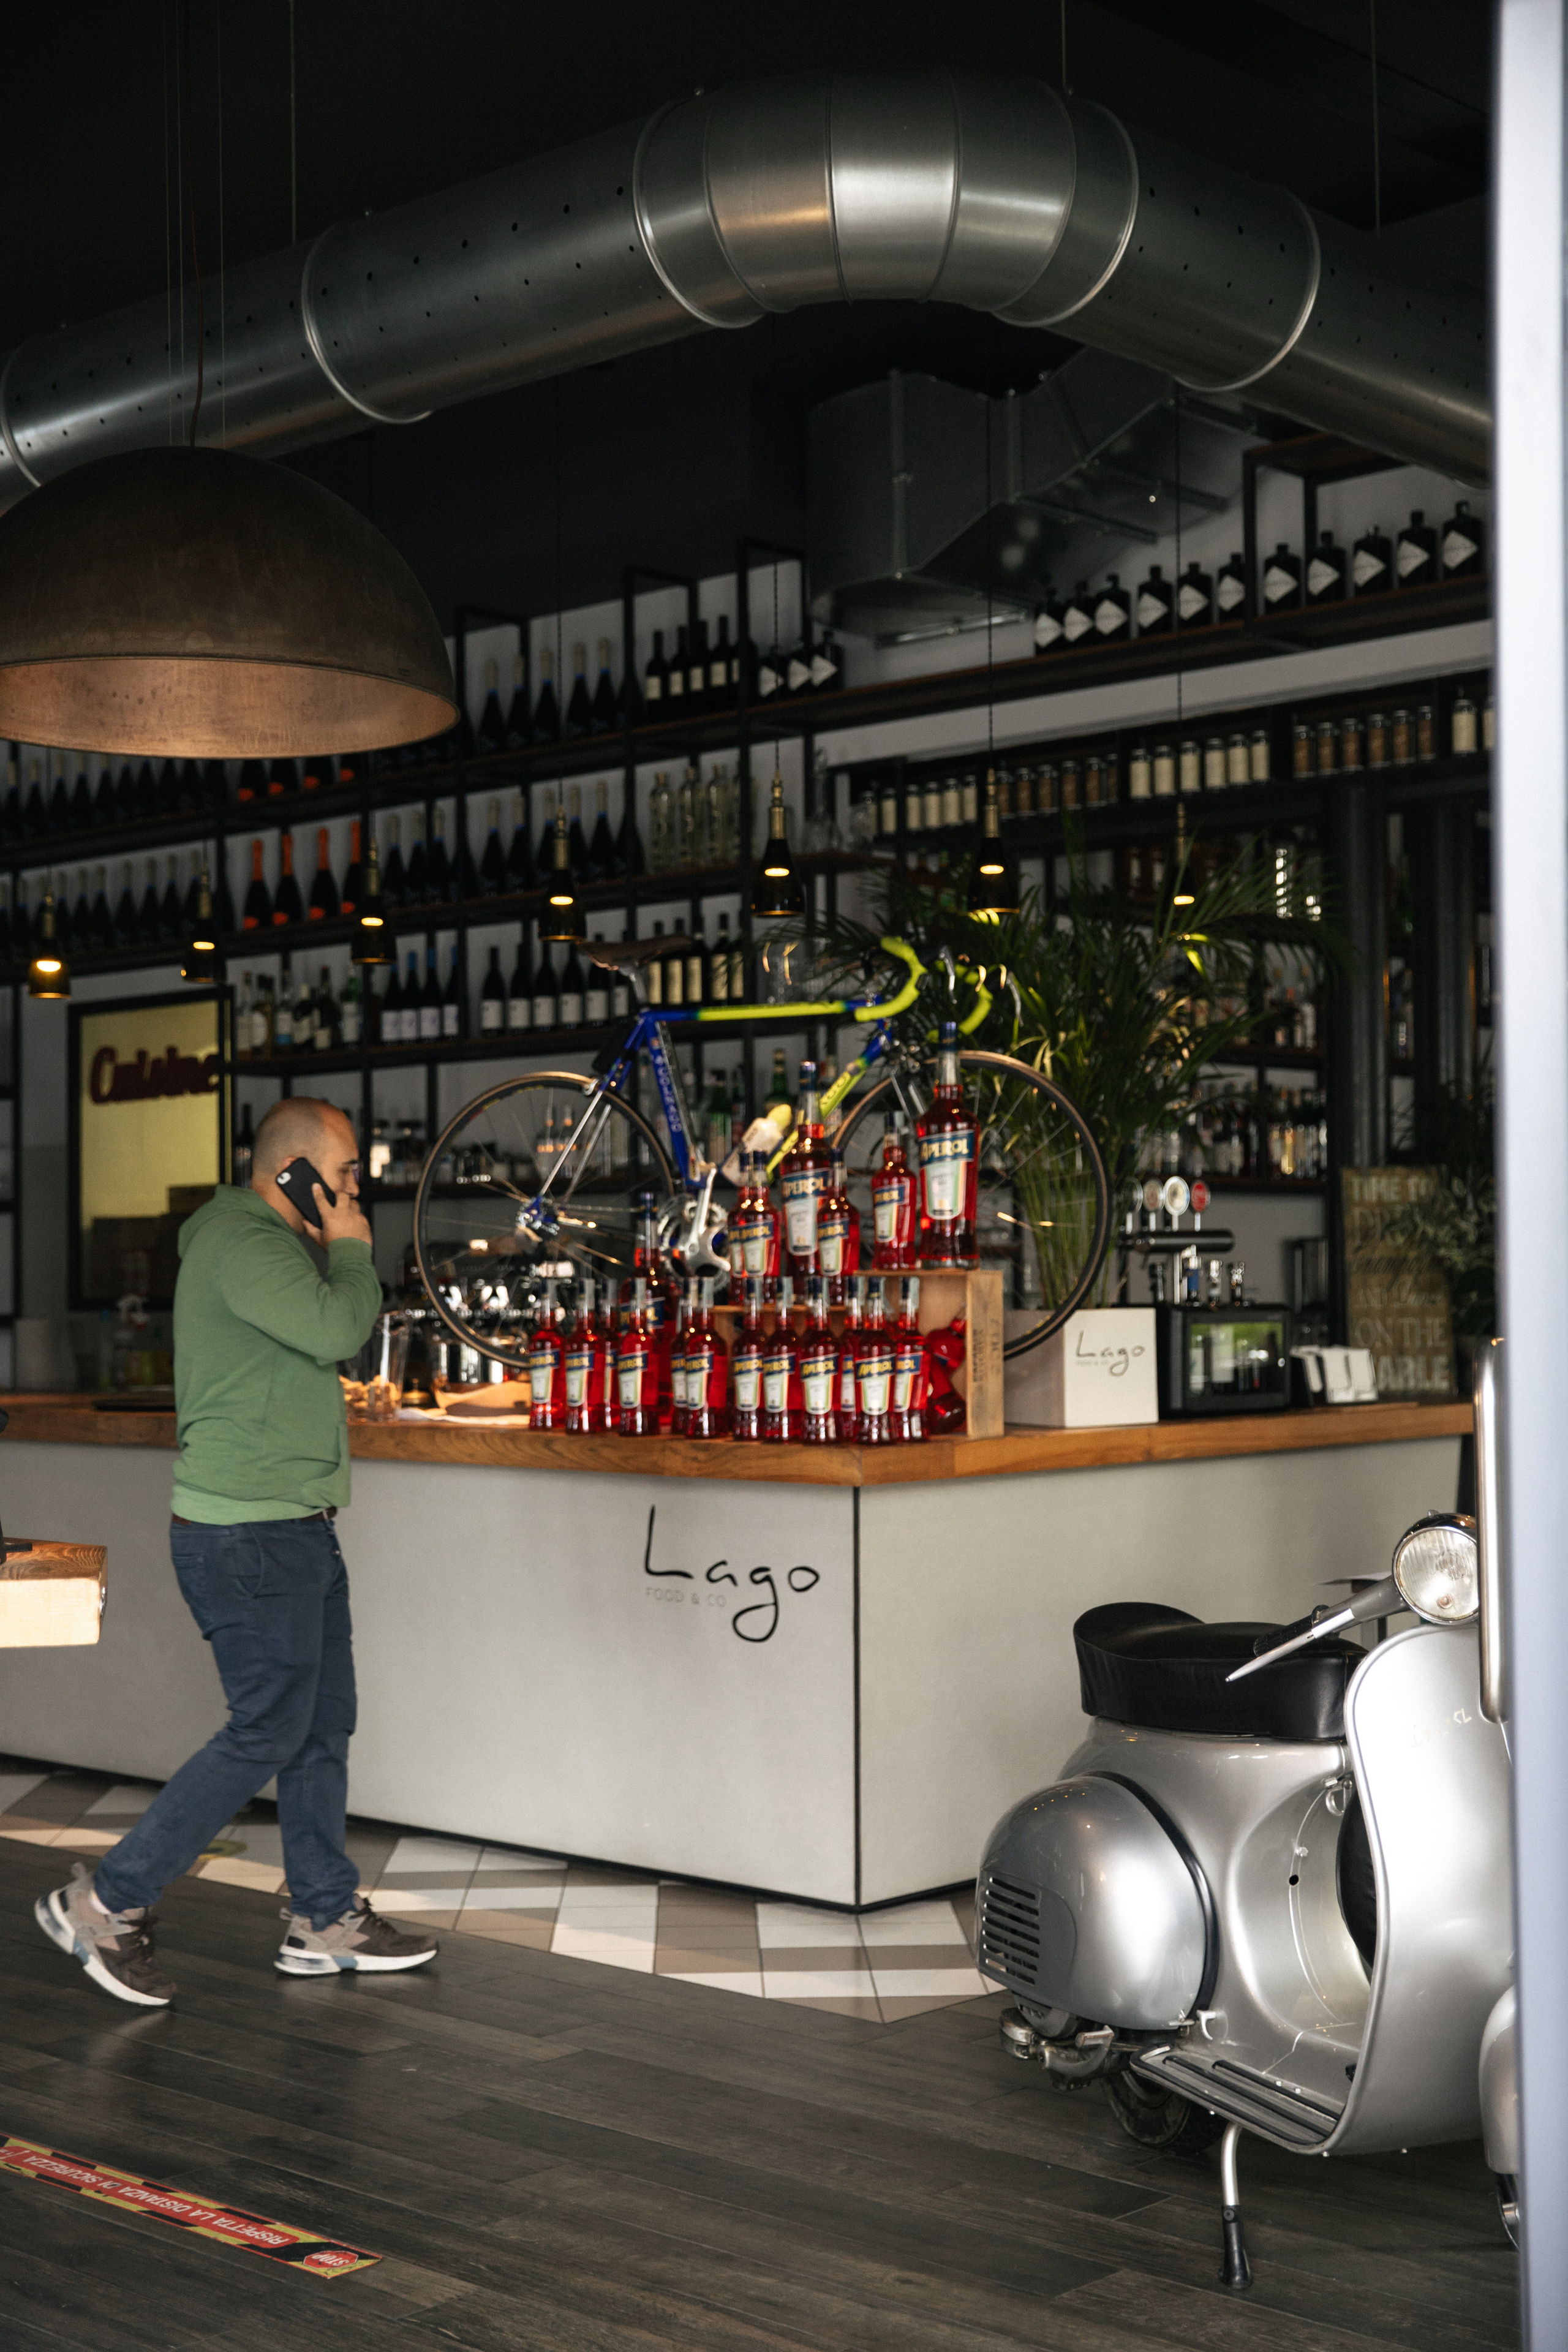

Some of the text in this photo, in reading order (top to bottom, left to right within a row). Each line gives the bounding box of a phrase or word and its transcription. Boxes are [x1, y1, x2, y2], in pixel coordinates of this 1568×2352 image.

[921, 1137, 970, 1161] APEROL
[1350, 1175, 1401, 1203] TIME
[1355, 1316, 1447, 1349] ON THE
[1076, 1330, 1145, 1377] Lago
[858, 1360, 893, 1378] APEROL
[1376, 1354, 1450, 1392] ABLE
[644, 1504, 820, 1643] Lago
[645, 1586, 685, 1604] FOOD
[707, 1593, 727, 1608] CO
[23, 2155, 289, 2245] RISPETTA LA DISTANZA DI SICUREZZA
[311, 2253, 350, 2267] STOP
